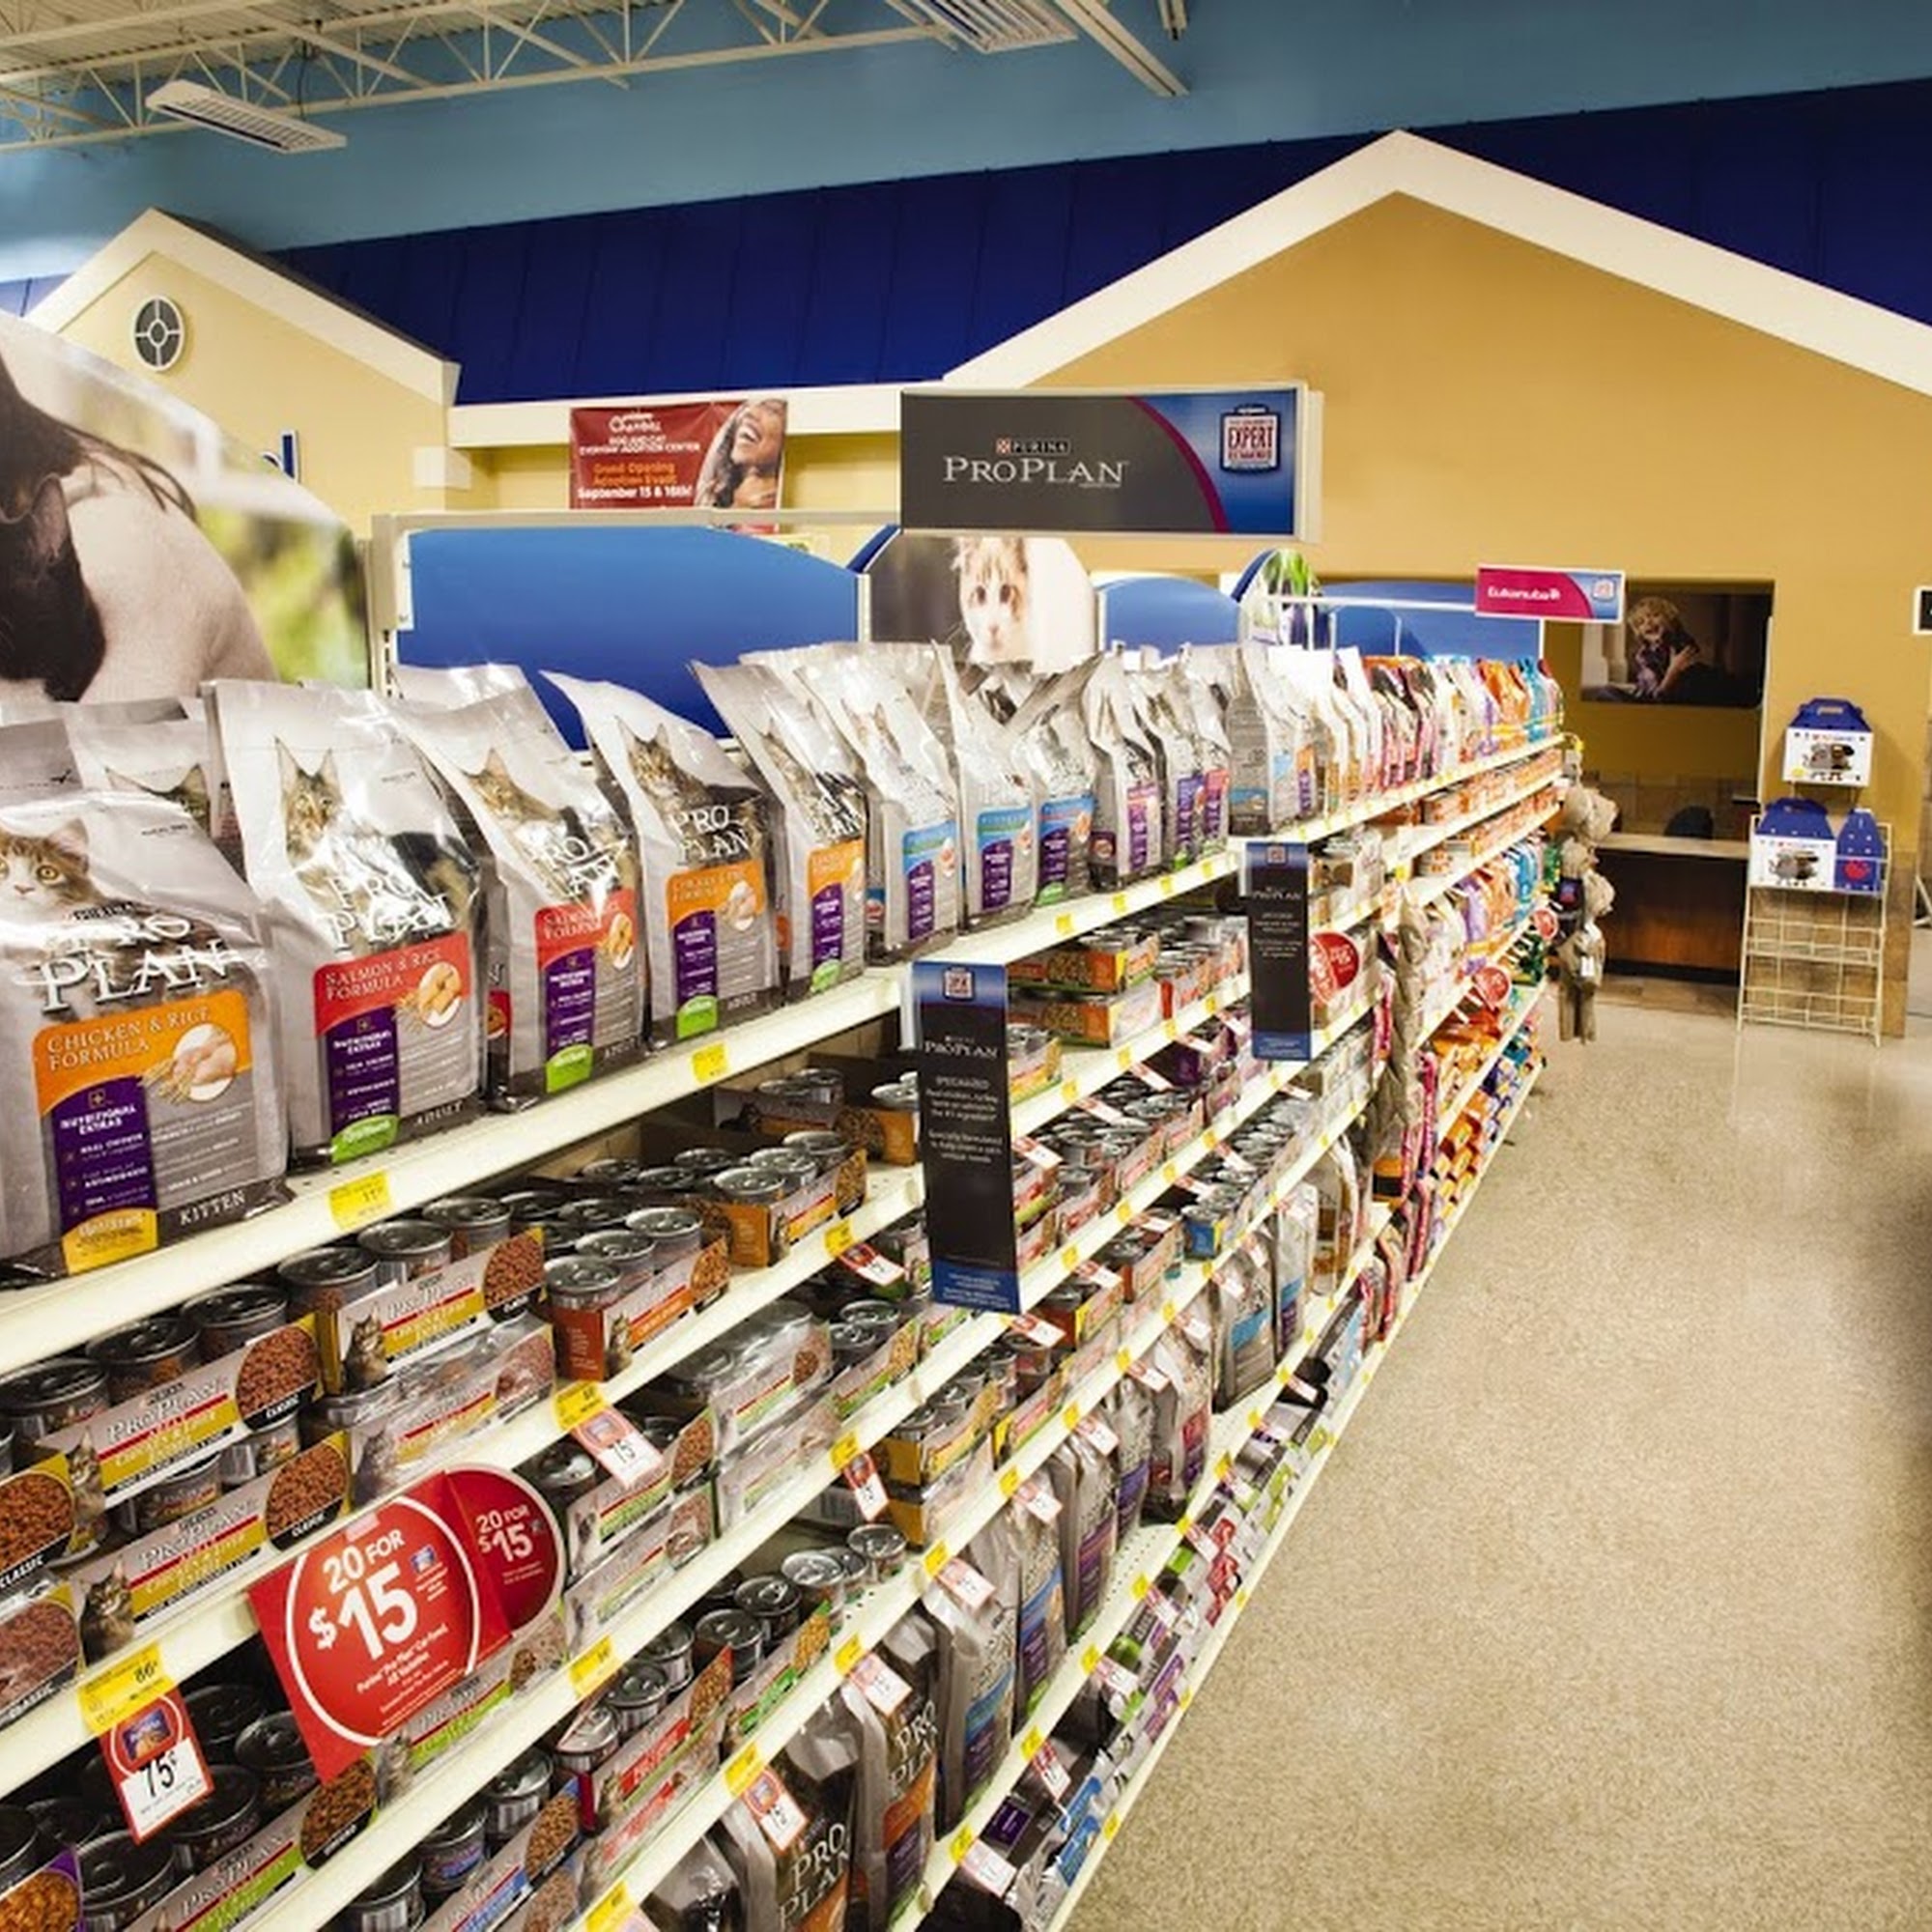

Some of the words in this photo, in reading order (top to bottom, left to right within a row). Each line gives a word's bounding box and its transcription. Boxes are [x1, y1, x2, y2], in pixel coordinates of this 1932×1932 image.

[1228, 426, 1273, 448] EXPERT
[578, 486, 638, 499] September
[668, 805, 729, 836] PRO
[41, 938, 228, 1014] PLAN
[326, 961, 392, 986] SALMON
[326, 975, 404, 1002] FORMULA
[48, 1021, 142, 1054] CHICKEN
[149, 1019, 162, 1033] &
[167, 1007, 212, 1028] RICE
[49, 1039, 150, 1071] FORMULA
[180, 1190, 246, 1226] KITTEN
[475, 1510, 503, 1534] 20
[477, 1522, 533, 1563] $15
[0, 1554, 44, 1588] CLASSIC
[323, 1545, 365, 1596] 20
[365, 1529, 406, 1565] FOR
[307, 1560, 417, 1662] $15
[790, 1823, 846, 1893] PRO
